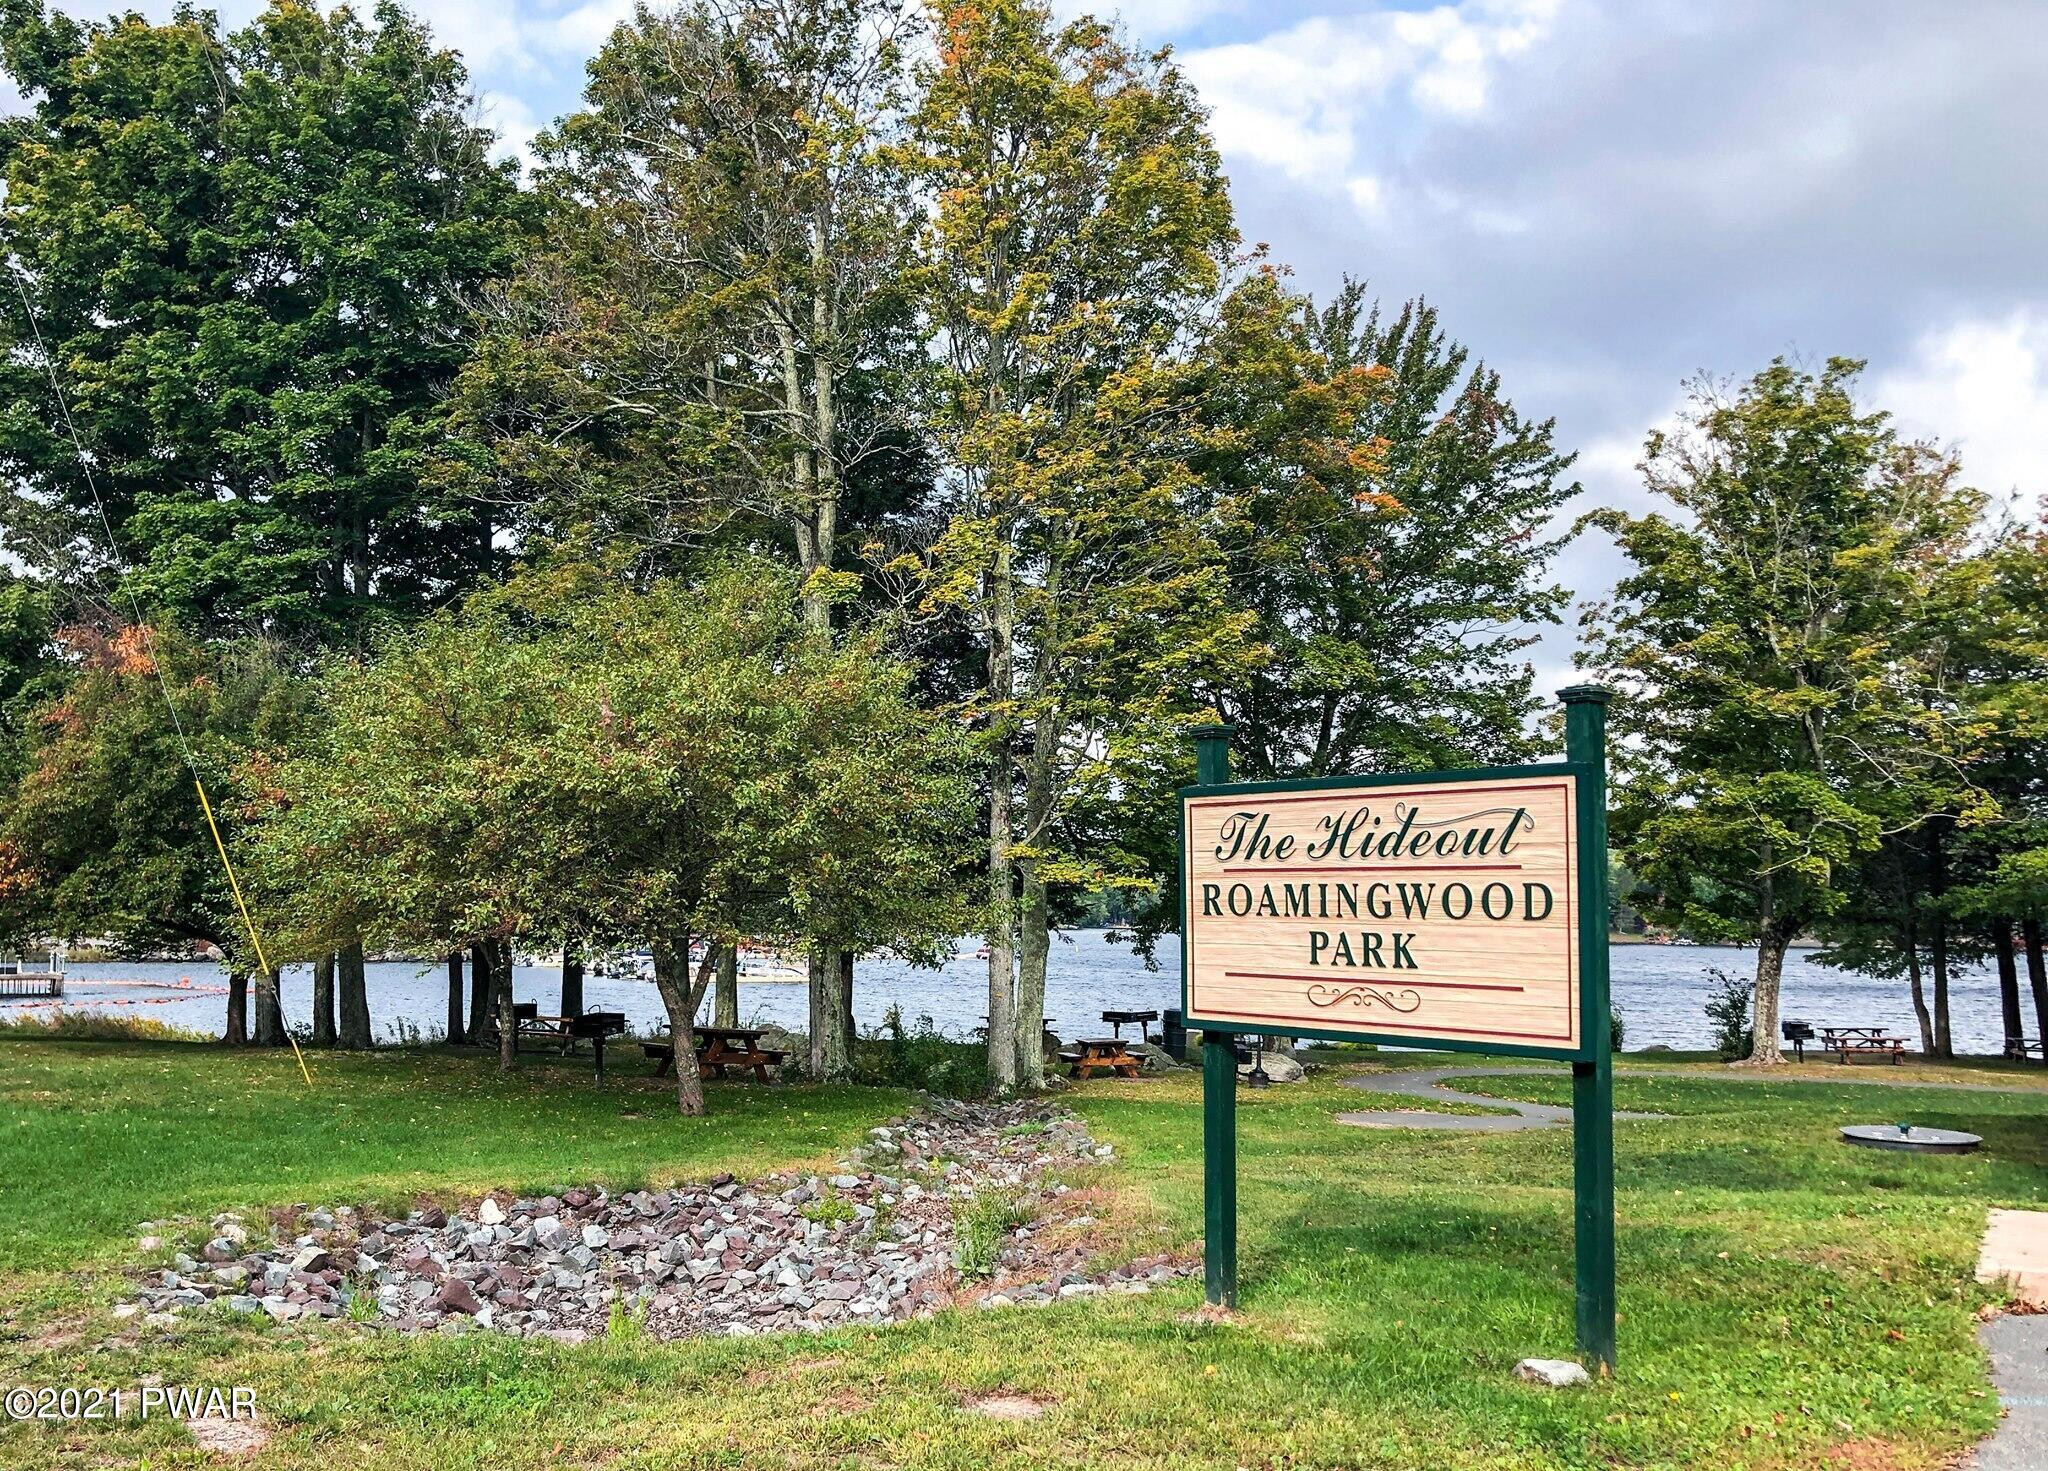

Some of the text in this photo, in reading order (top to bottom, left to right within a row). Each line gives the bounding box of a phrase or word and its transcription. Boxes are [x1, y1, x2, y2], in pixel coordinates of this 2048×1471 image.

[1215, 802, 1535, 861] The Hideout
[1202, 881, 1554, 922] ROAMINGWOOD
[1309, 930, 1420, 969] PARK
